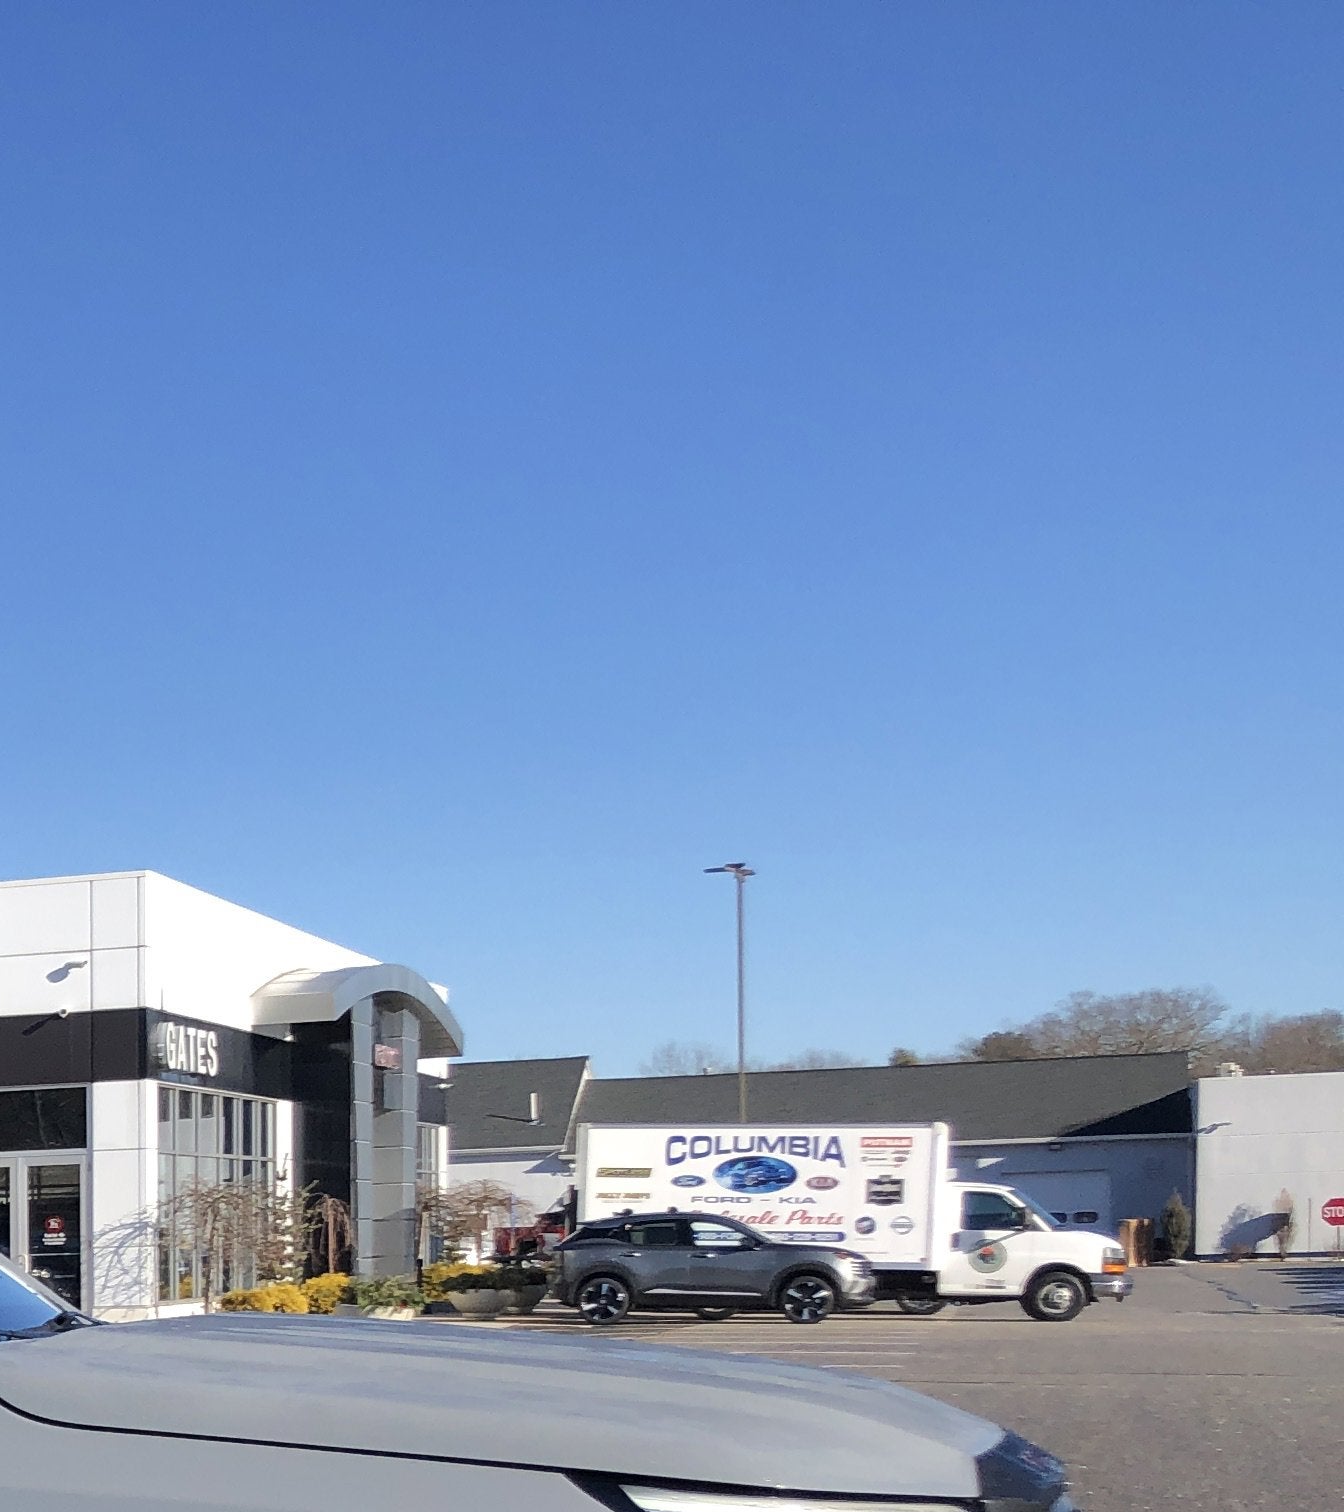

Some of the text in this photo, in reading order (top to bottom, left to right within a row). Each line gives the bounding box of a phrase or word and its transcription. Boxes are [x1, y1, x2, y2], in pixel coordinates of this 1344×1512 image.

[165, 1021, 219, 1077] GATES
[665, 1135, 846, 1168] COLUMBIA
[691, 1196, 751, 1204] FORD
[778, 1196, 817, 1204] KIA
[785, 1209, 845, 1225] Parts
[1323, 1206, 1344, 1218] STO
